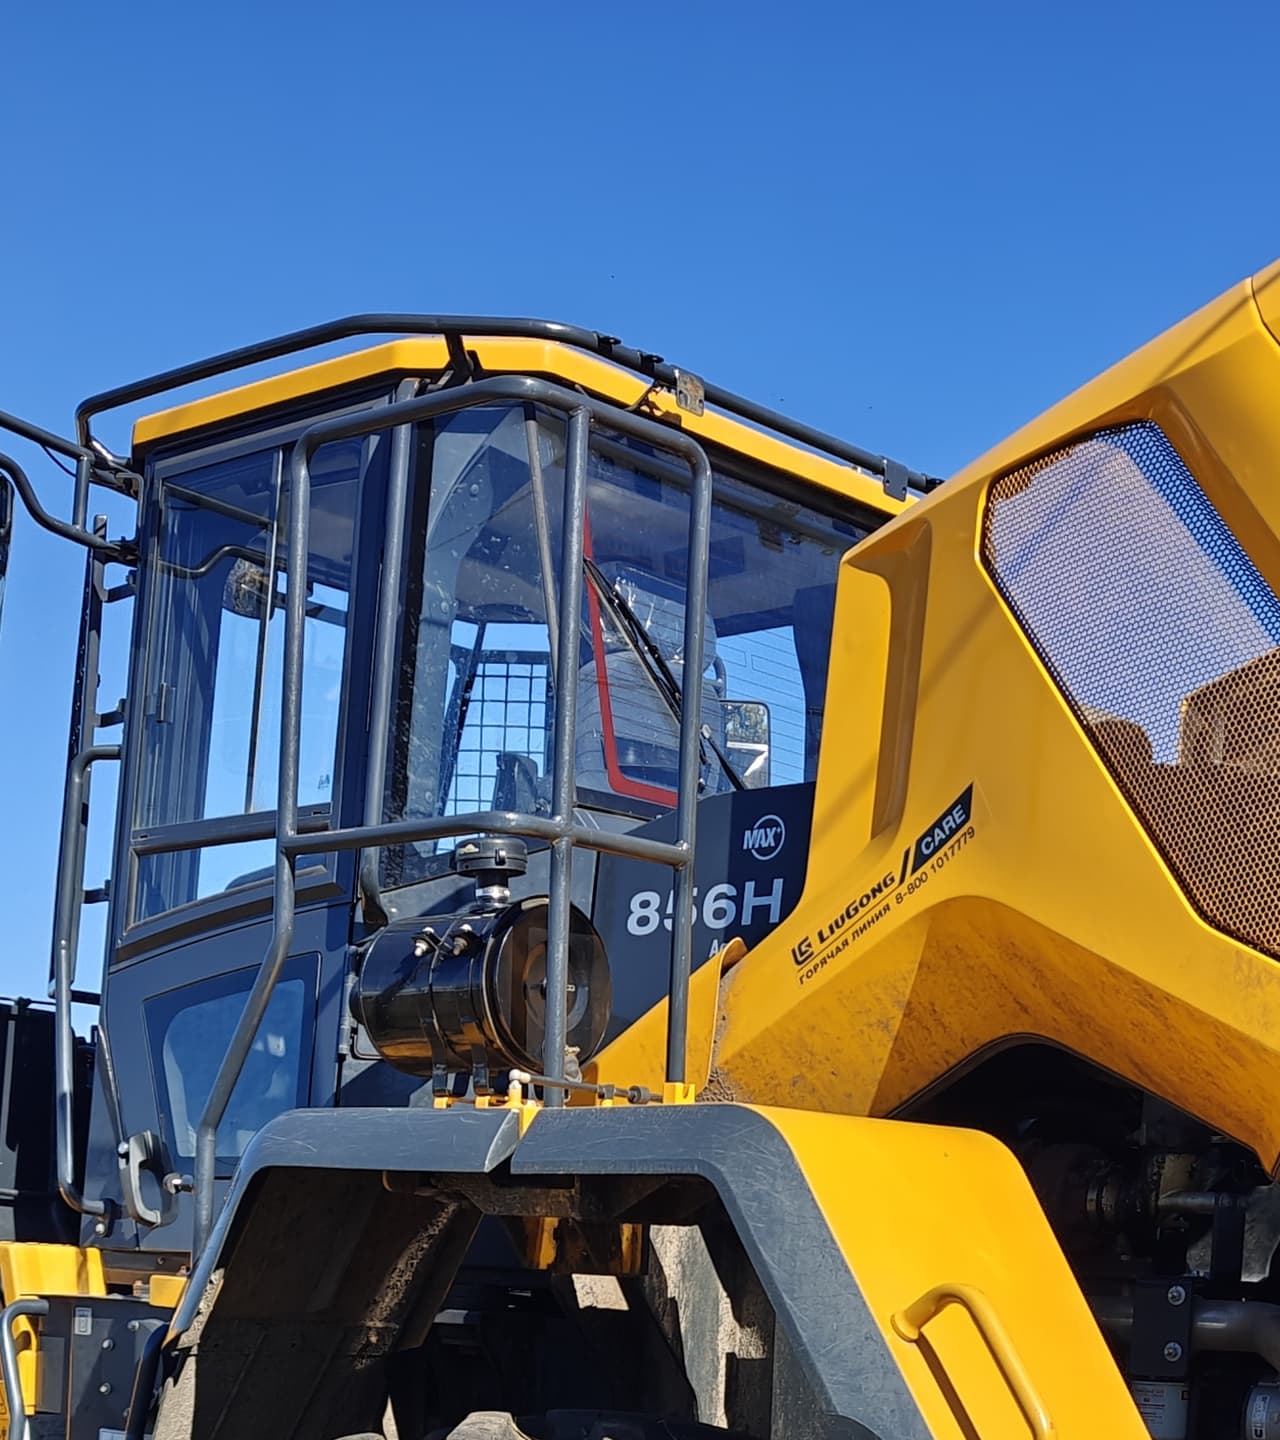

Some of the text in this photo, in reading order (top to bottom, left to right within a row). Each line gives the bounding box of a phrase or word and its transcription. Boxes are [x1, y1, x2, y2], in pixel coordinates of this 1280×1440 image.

[920, 804, 967, 855] CARE
[799, 825, 975, 985] ГОРЯЧАЯ ЛИНИЯ 8-800 1017779
